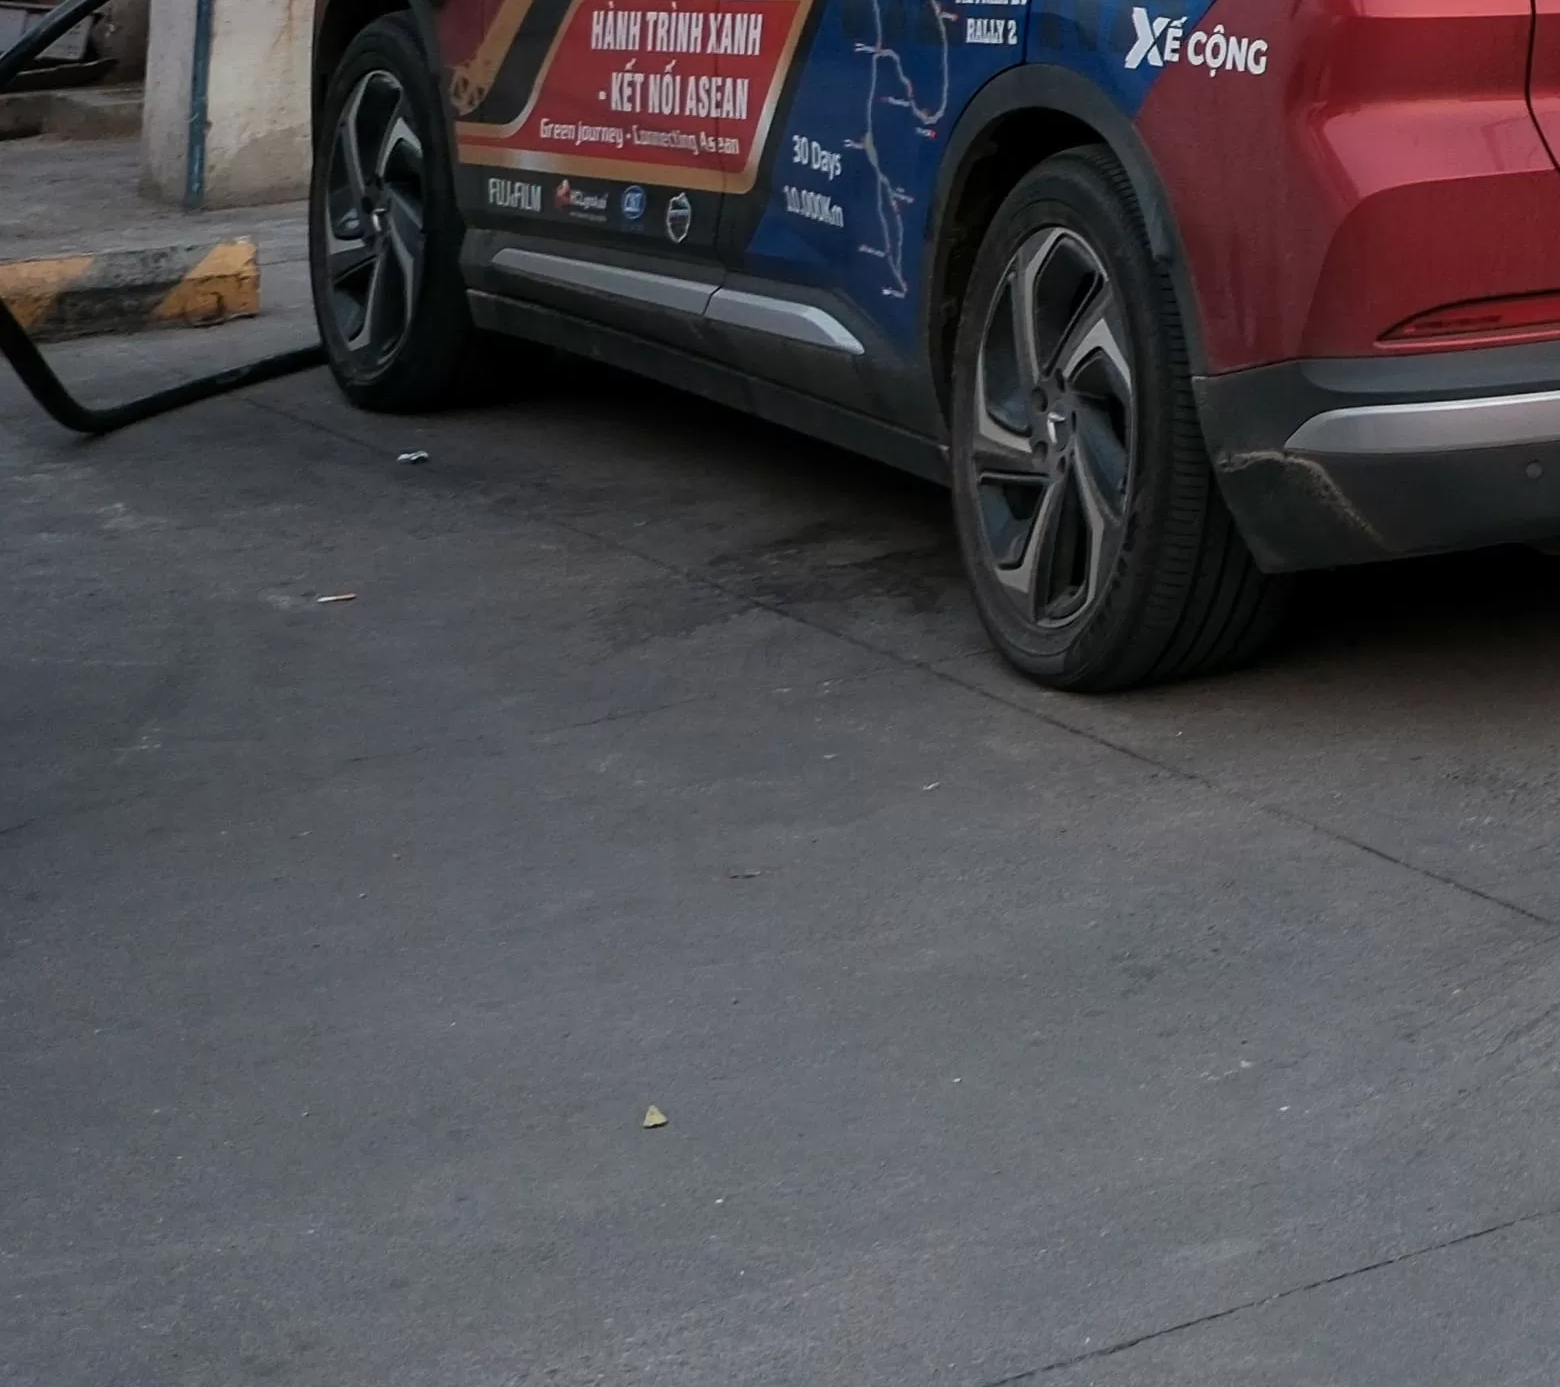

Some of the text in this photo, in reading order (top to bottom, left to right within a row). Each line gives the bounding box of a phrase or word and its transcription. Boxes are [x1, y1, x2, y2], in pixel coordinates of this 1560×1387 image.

[591, 0, 764, 56] HÀNH TRÌNH XANH
[965, 17, 1018, 45] RALLY 2
[1124, 6, 1268, 78] XẾ CỘNG
[684, 75, 749, 121] ASEAN
[539, 117, 576, 141] Green
[792, 134, 842, 181] 30 Days
